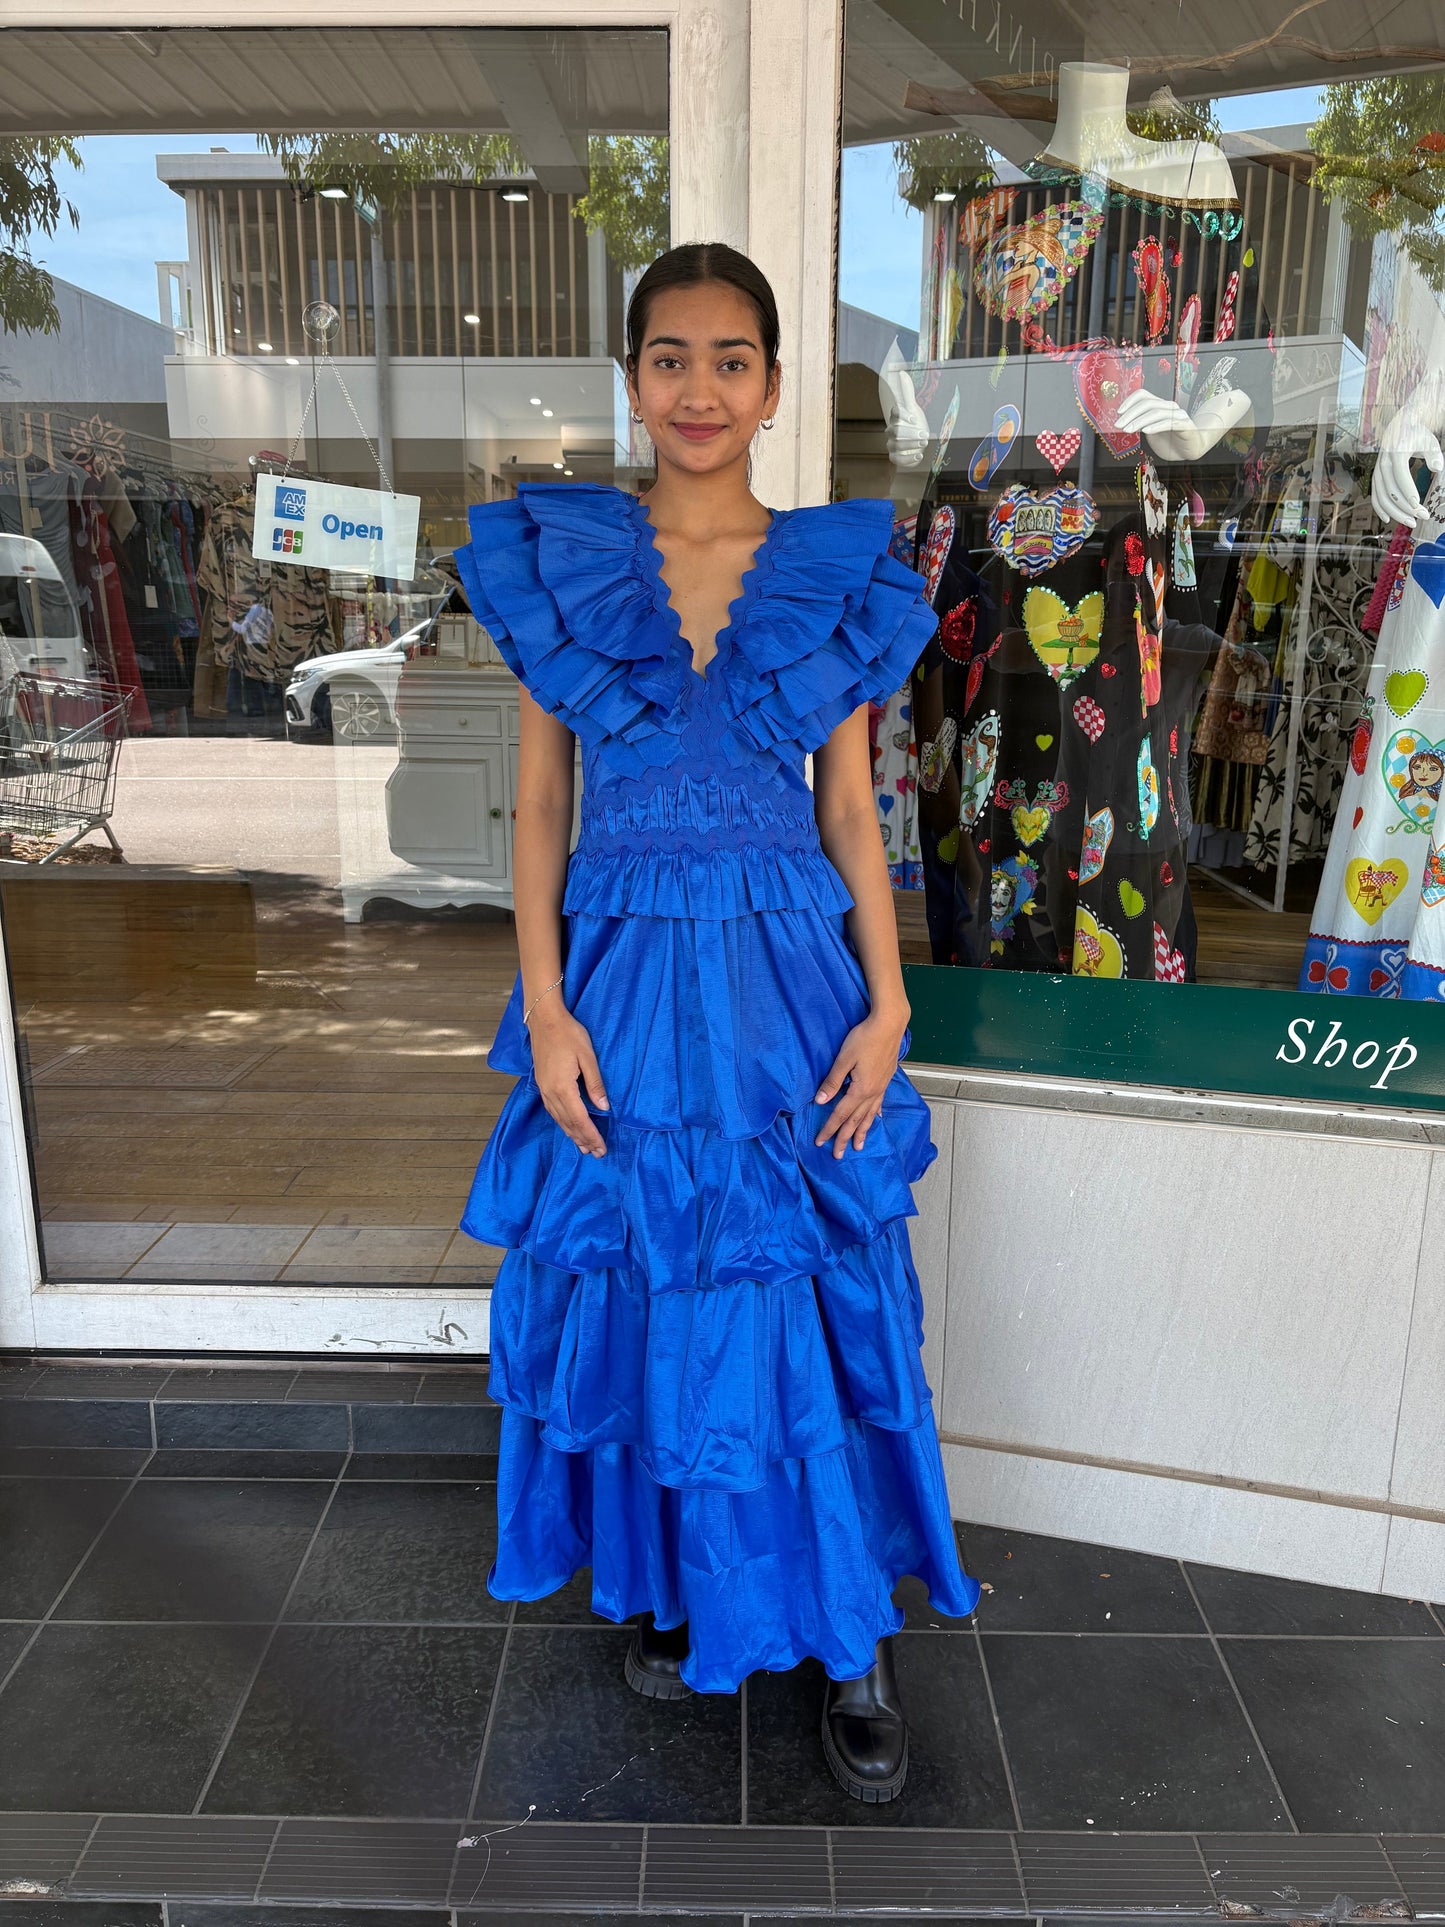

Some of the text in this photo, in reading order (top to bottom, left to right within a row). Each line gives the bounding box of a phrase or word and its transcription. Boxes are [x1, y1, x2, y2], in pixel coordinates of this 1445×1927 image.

[273, 532, 303, 549] JCB
[322, 513, 383, 541] Open
[1276, 1018, 1418, 1090] Shop
